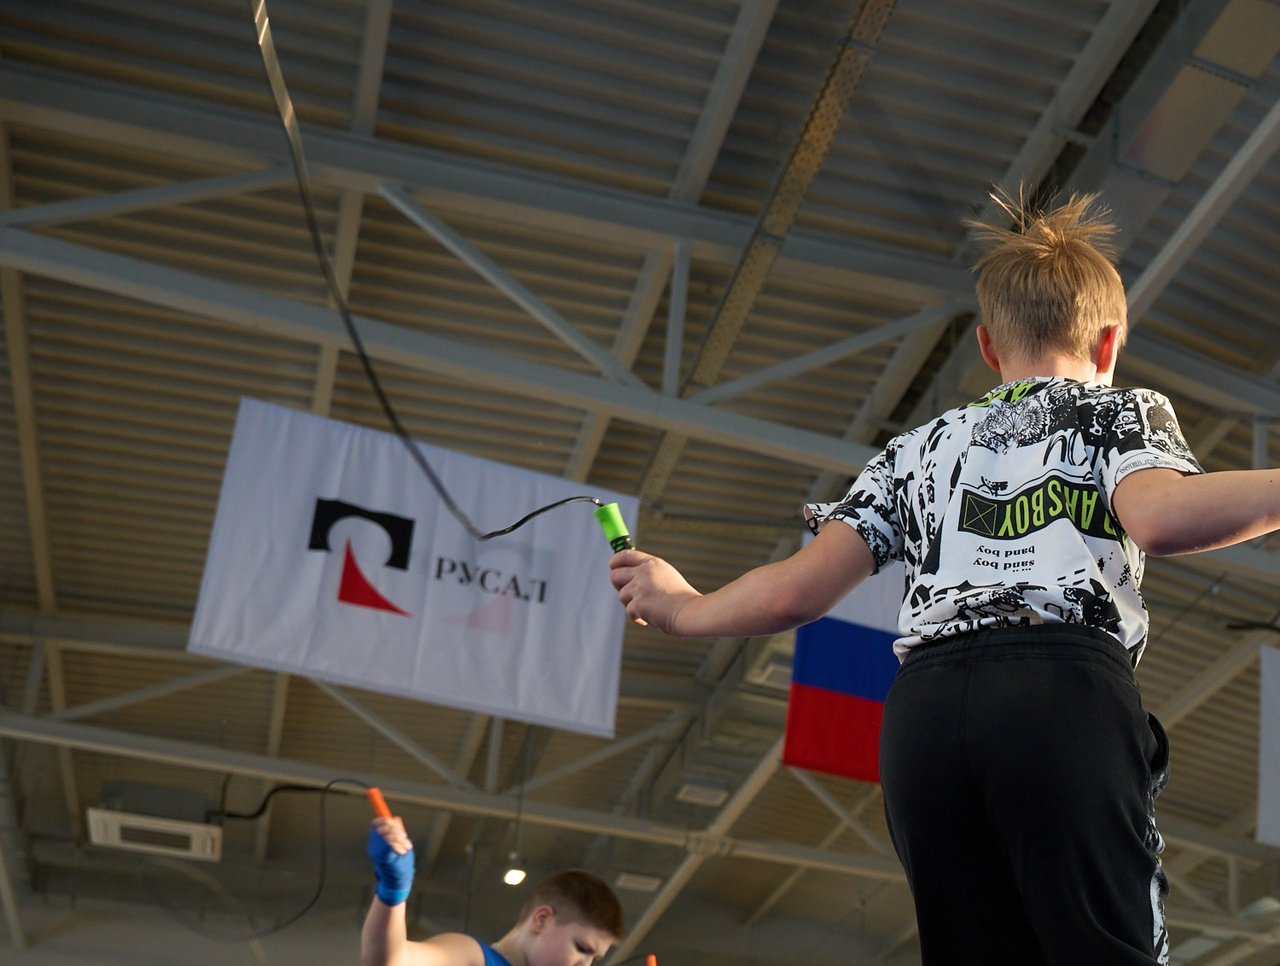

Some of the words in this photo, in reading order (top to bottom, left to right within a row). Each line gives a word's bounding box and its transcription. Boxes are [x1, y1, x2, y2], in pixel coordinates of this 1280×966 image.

[976, 545, 1000, 558] boy
[1004, 545, 1035, 558] band
[973, 557, 999, 570] boy
[1003, 559, 1035, 571] sand
[434, 556, 549, 604] РУСАЛ
